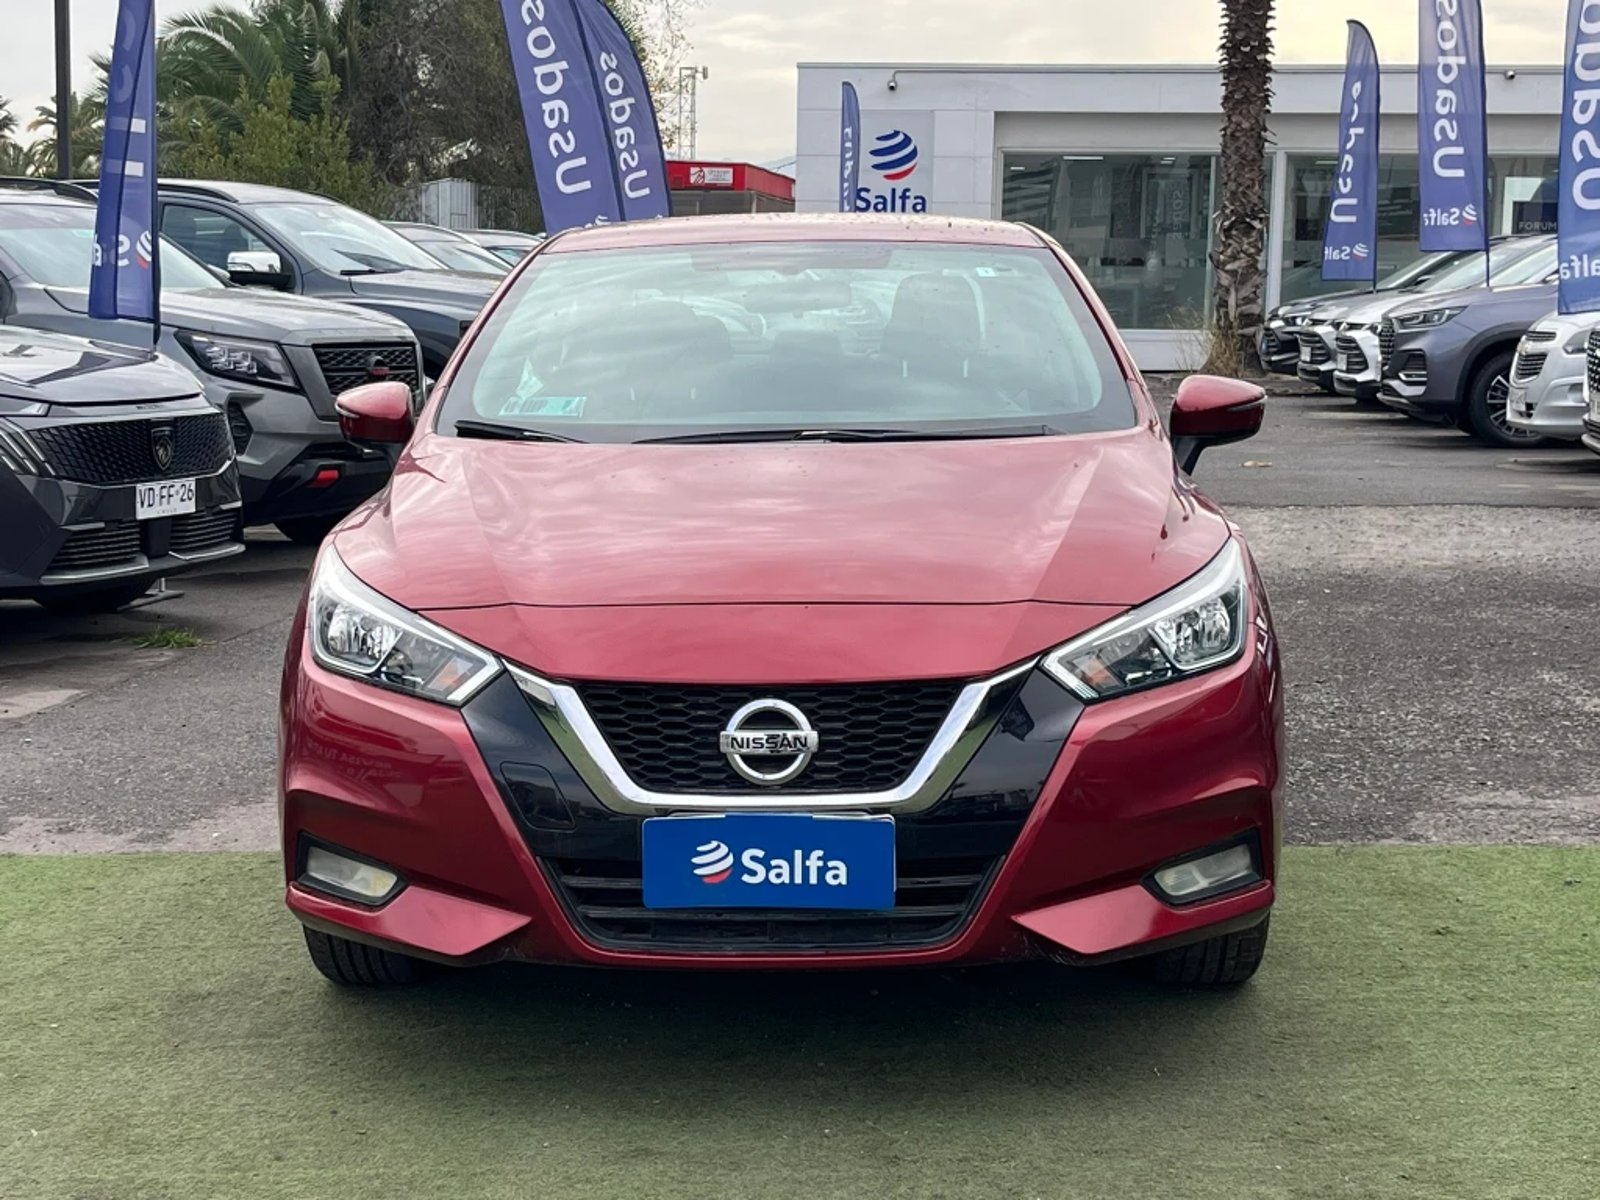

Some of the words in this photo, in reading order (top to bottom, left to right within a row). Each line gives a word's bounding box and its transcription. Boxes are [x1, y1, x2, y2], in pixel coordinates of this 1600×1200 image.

[855, 187, 927, 213] Salfa
[1519, 222, 1557, 231] FORUM
[730, 736, 808, 750] NISSAN
[741, 848, 847, 885] Salfa
